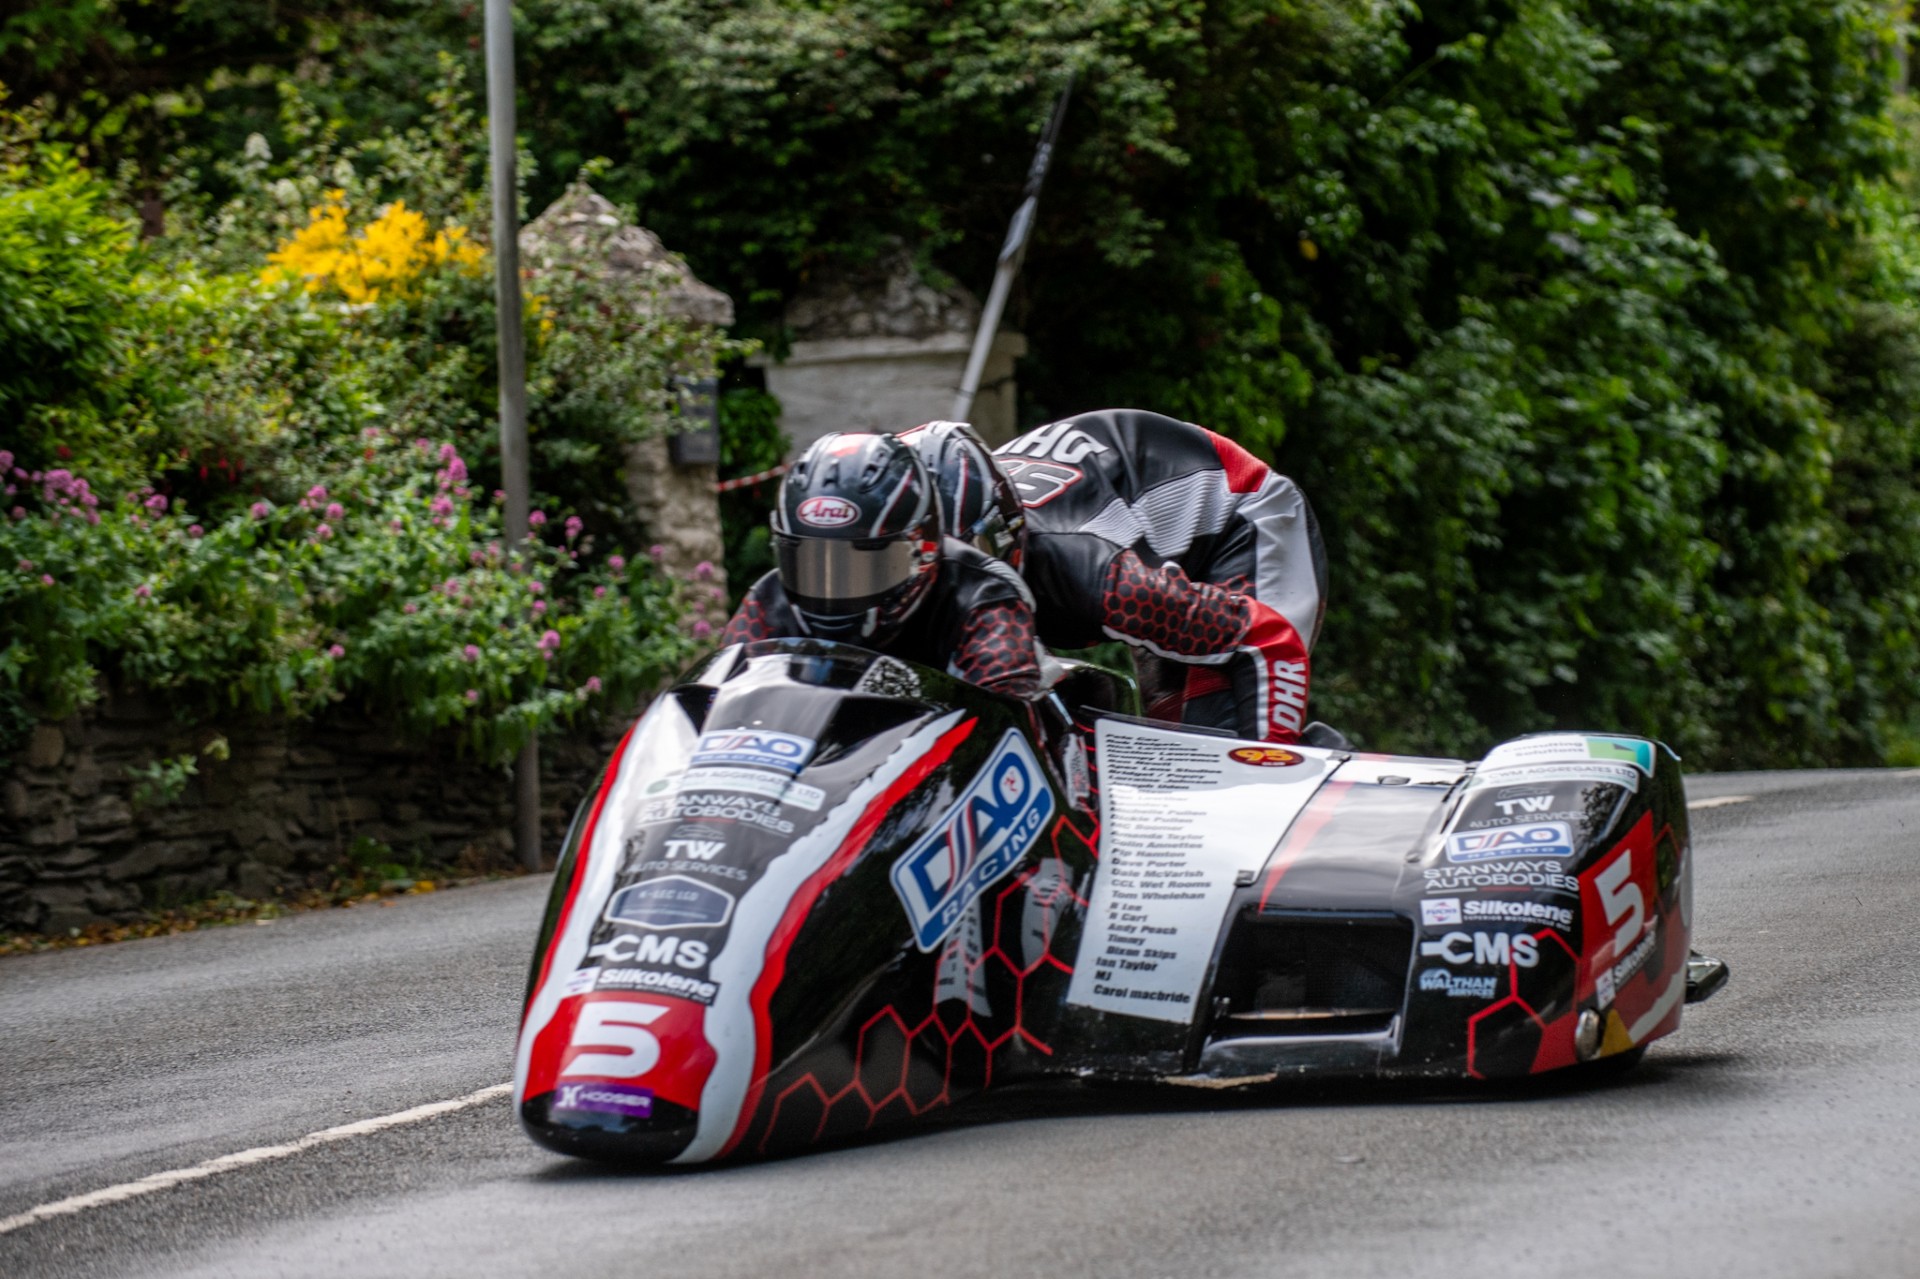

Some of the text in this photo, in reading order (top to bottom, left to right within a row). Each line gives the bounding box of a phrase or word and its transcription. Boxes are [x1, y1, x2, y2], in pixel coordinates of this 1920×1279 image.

[799, 497, 850, 519] Arai
[1272, 660, 1306, 733] DHR
[1234, 749, 1294, 763] 95
[1615, 767, 1637, 780] LTD
[1496, 795, 1554, 815] TW
[1470, 811, 1588, 828] AUTO SERVICES
[664, 840, 726, 860] TW
[671, 861, 748, 880] SERVICES
[941, 807, 1043, 925] RACING
[1111, 858, 1144, 867] Dave
[1423, 860, 1562, 880] STANWAYS
[1140, 881, 1165, 889] Wet
[1167, 881, 1212, 889] Rooms
[1425, 873, 1580, 891] AUTOBODIES
[1111, 890, 1138, 899] Tom
[1594, 848, 1645, 957] 5
[1463, 900, 1573, 925] Silkolene
[1107, 923, 1137, 934] Andy
[589, 933, 709, 969] CMS
[1420, 931, 1539, 968] CMS
[1096, 957, 1158, 972] Ian Taylor
[598, 968, 716, 998] Silkolene
[1095, 970, 1113, 981] MJ
[1094, 984, 1191, 1004] Carol macbride
[560, 1001, 671, 1078] 5
